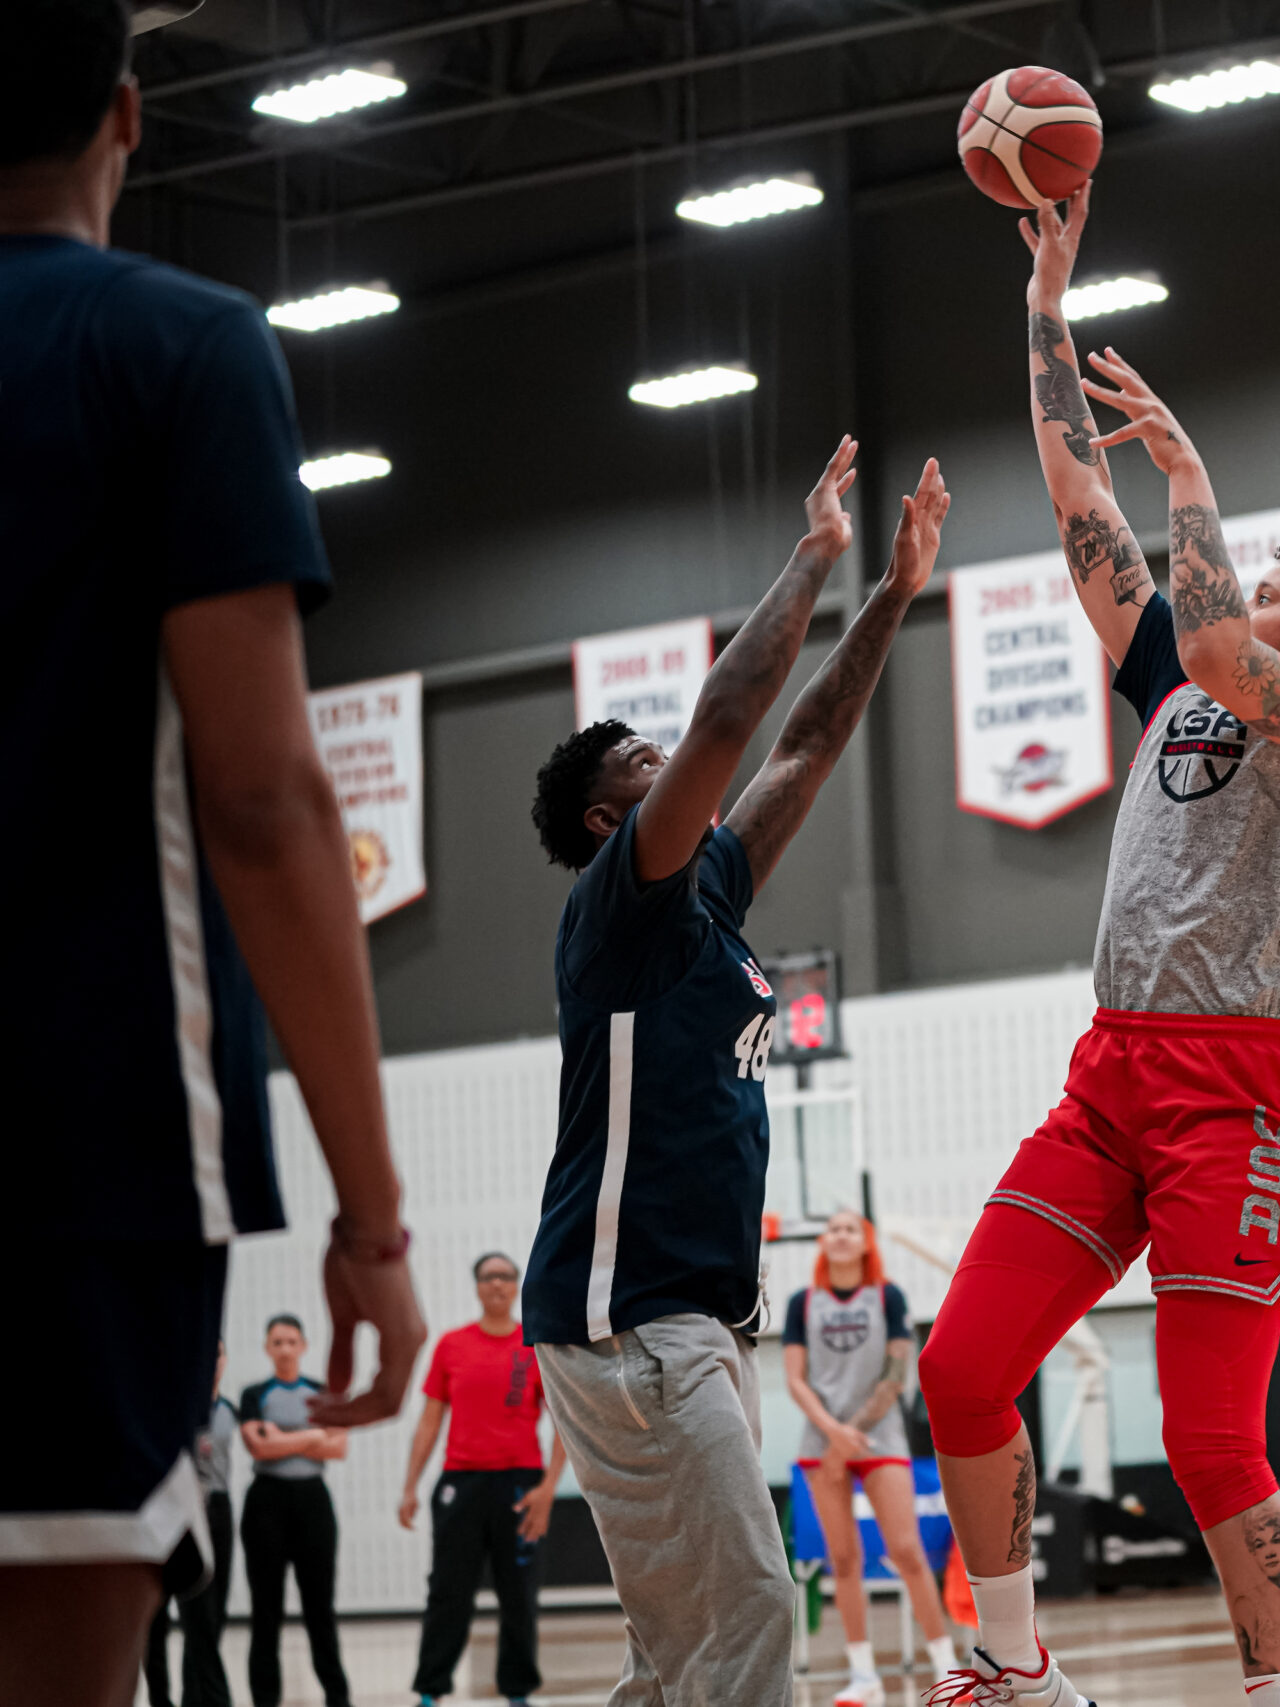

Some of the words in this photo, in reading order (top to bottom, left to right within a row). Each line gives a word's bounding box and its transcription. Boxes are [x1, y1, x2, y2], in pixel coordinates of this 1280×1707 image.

[984, 619, 1071, 658] CENTRAL
[986, 655, 1070, 694] DIVISION
[974, 688, 1089, 732] CHAMPIONS
[734, 1013, 776, 1082] 48
